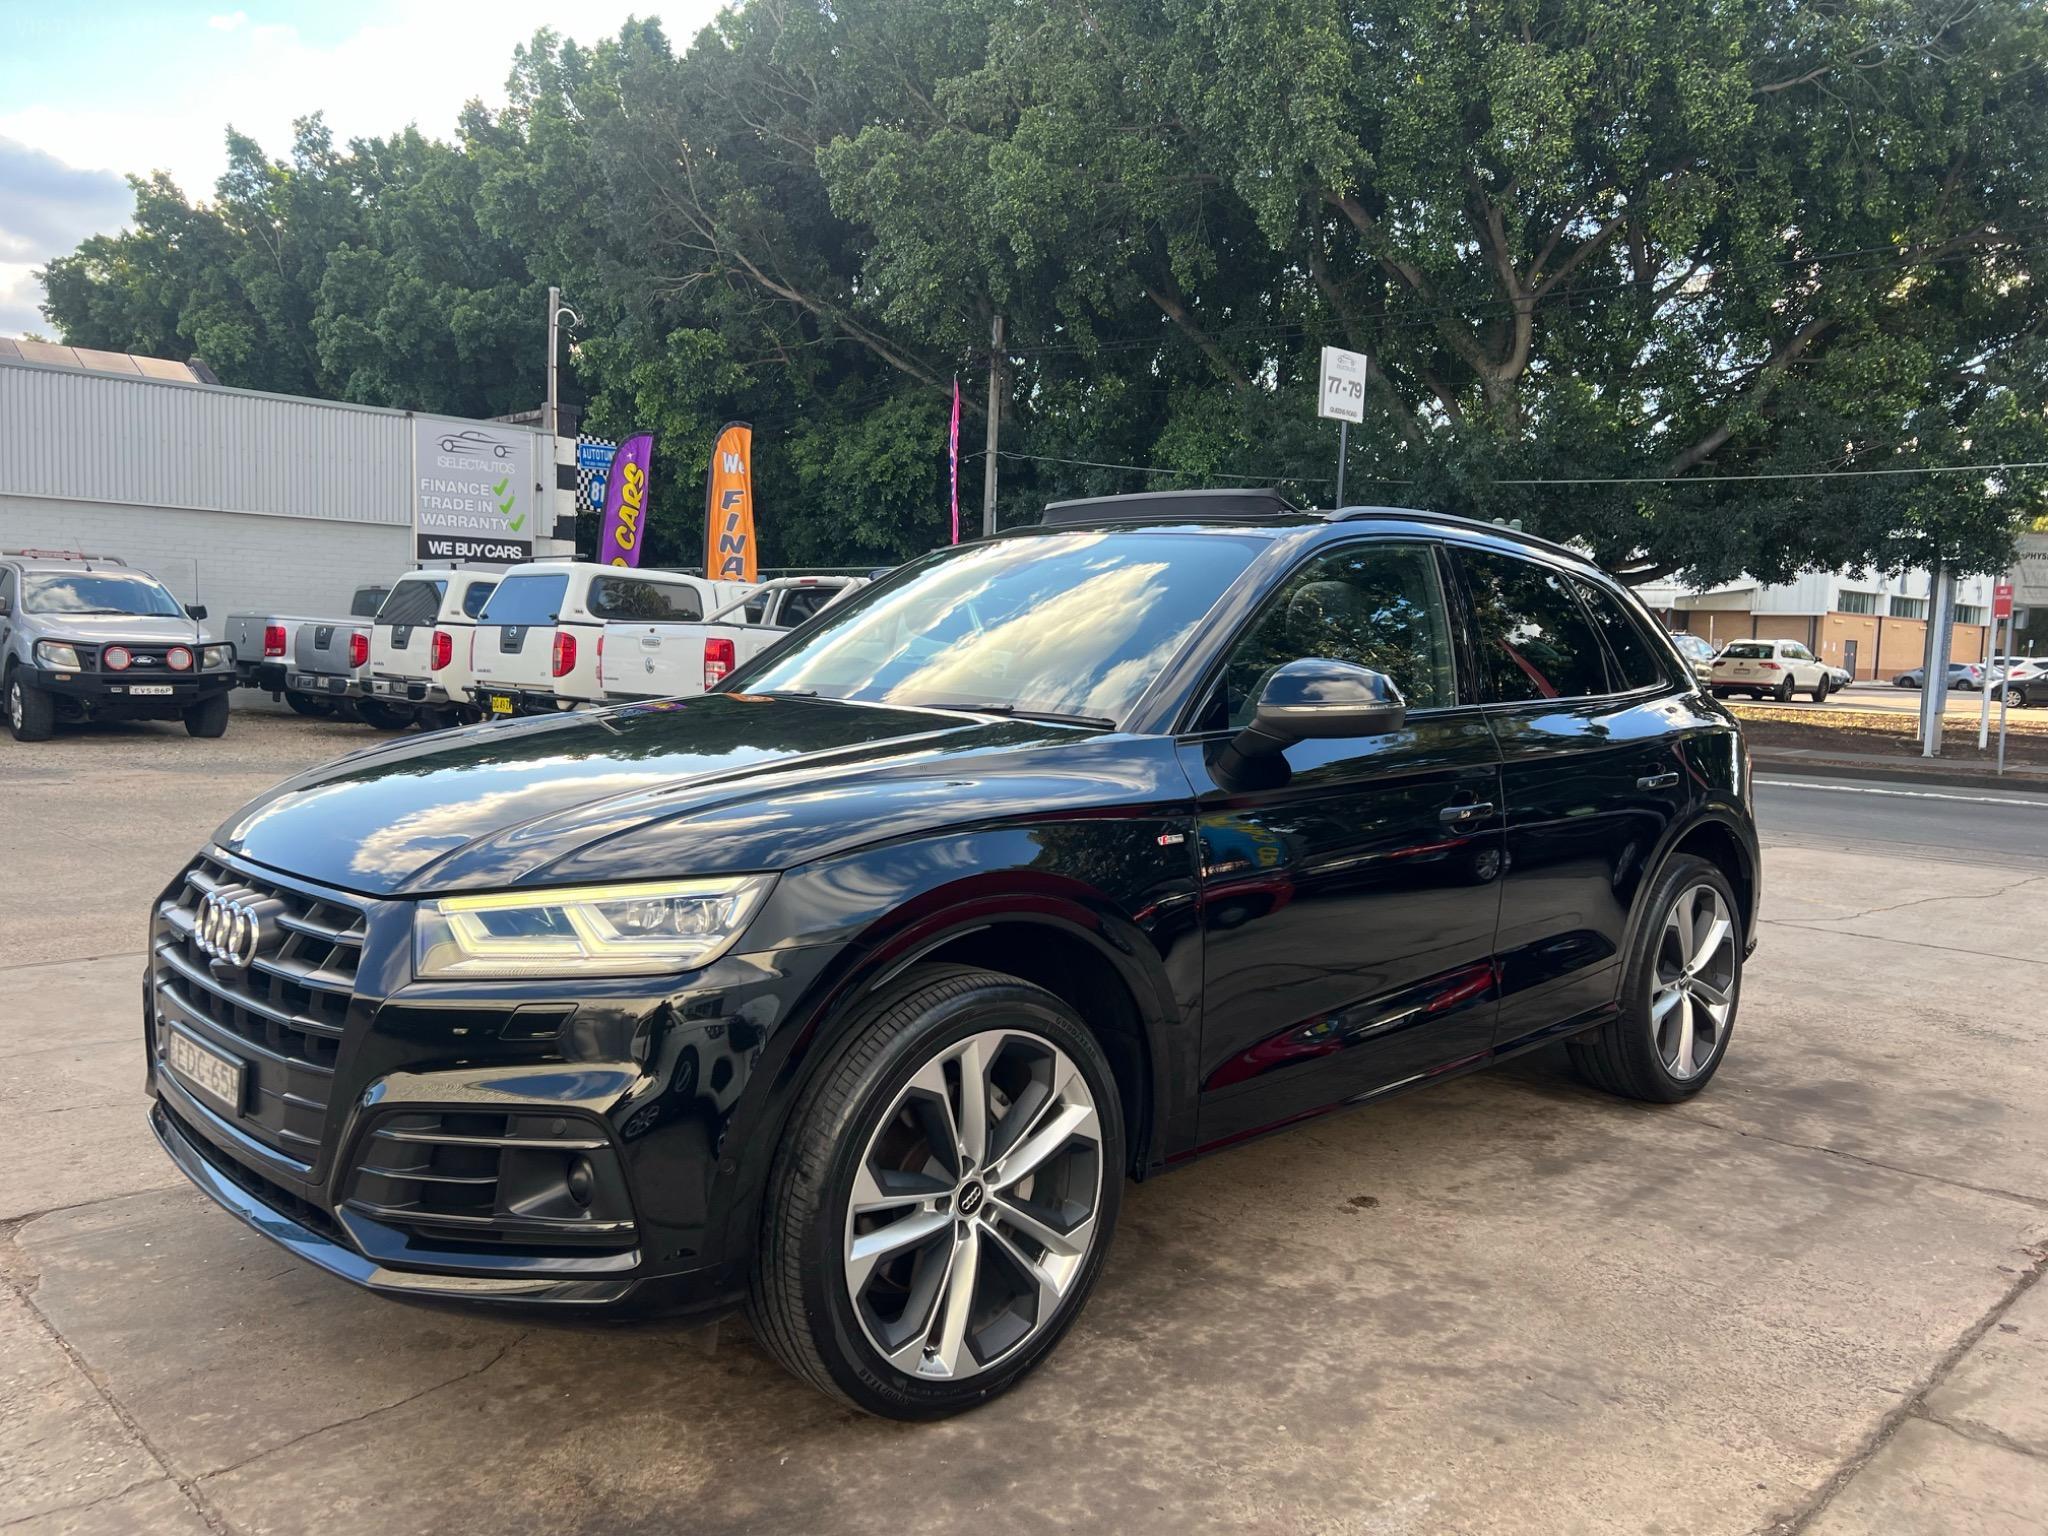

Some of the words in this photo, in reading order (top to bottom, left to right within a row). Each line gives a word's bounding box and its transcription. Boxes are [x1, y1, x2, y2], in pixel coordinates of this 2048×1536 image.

[437, 455, 516, 474] ISELECTAUTOS
[722, 451, 745, 475] We
[420, 478, 490, 497] FINANCE
[420, 495, 474, 511] TRADE
[477, 501, 493, 513] IN
[614, 462, 645, 551] CARS
[420, 512, 510, 530] WARRANTY
[719, 489, 747, 583] FINA
[428, 540, 453, 556] WE
[455, 542, 485, 557] BUY
[484, 544, 522, 560] CARS
[2024, 551, 2048, 561] PHYS
